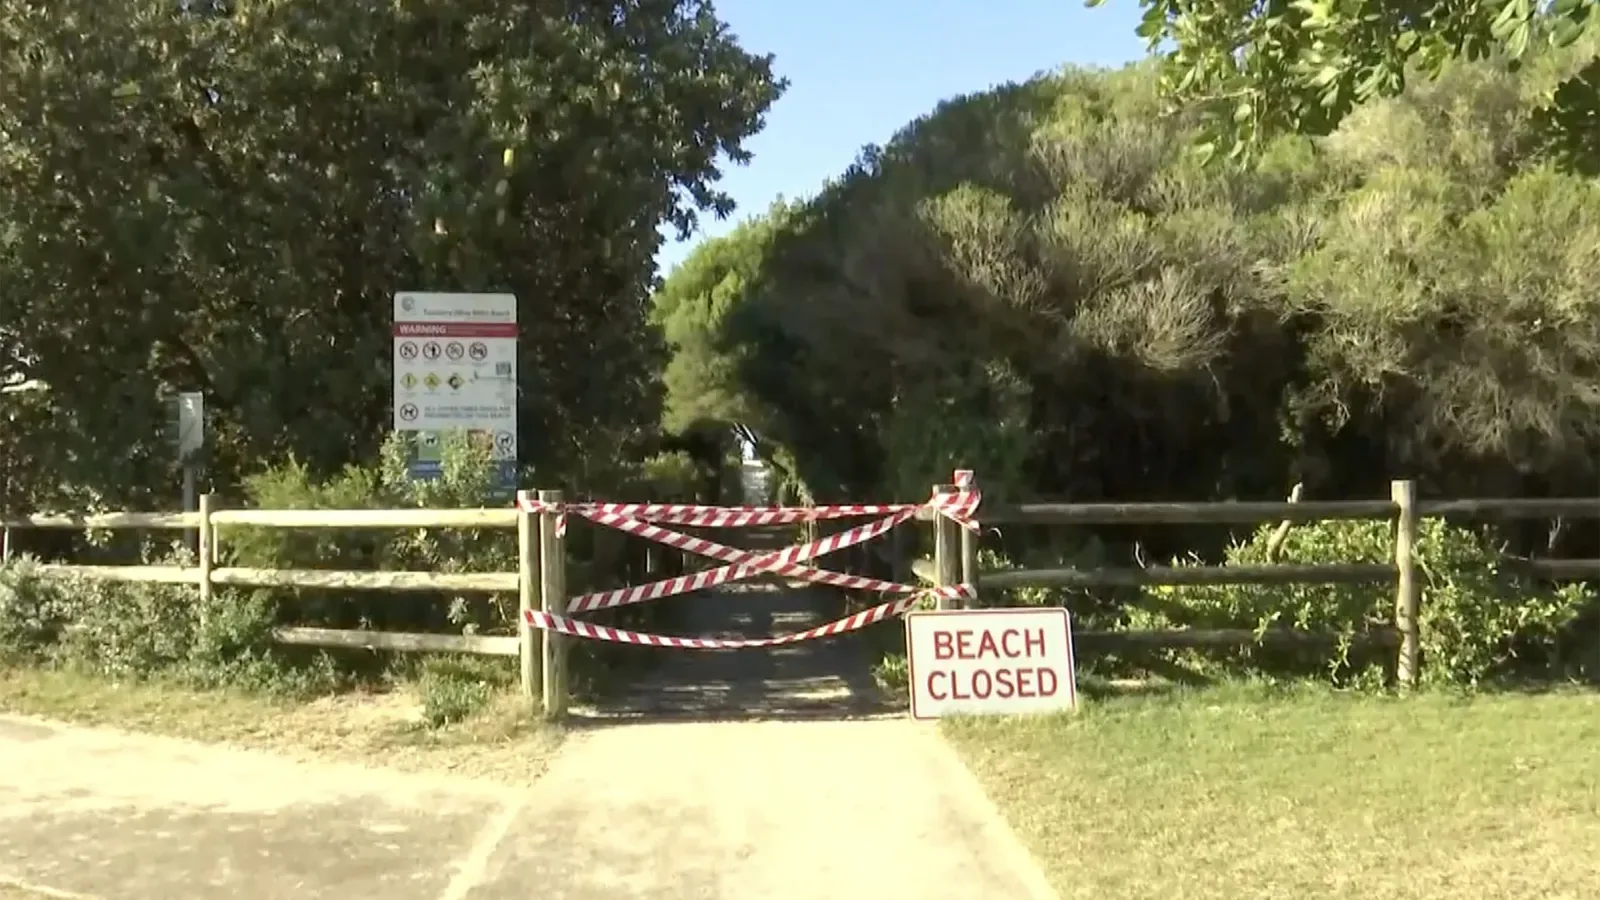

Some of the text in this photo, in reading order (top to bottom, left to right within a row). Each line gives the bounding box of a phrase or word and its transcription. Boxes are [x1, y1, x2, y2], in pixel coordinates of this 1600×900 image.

[399, 324, 447, 334] WARNING
[933, 628, 1046, 660] BEACH
[927, 667, 1058, 700] CLOSED
